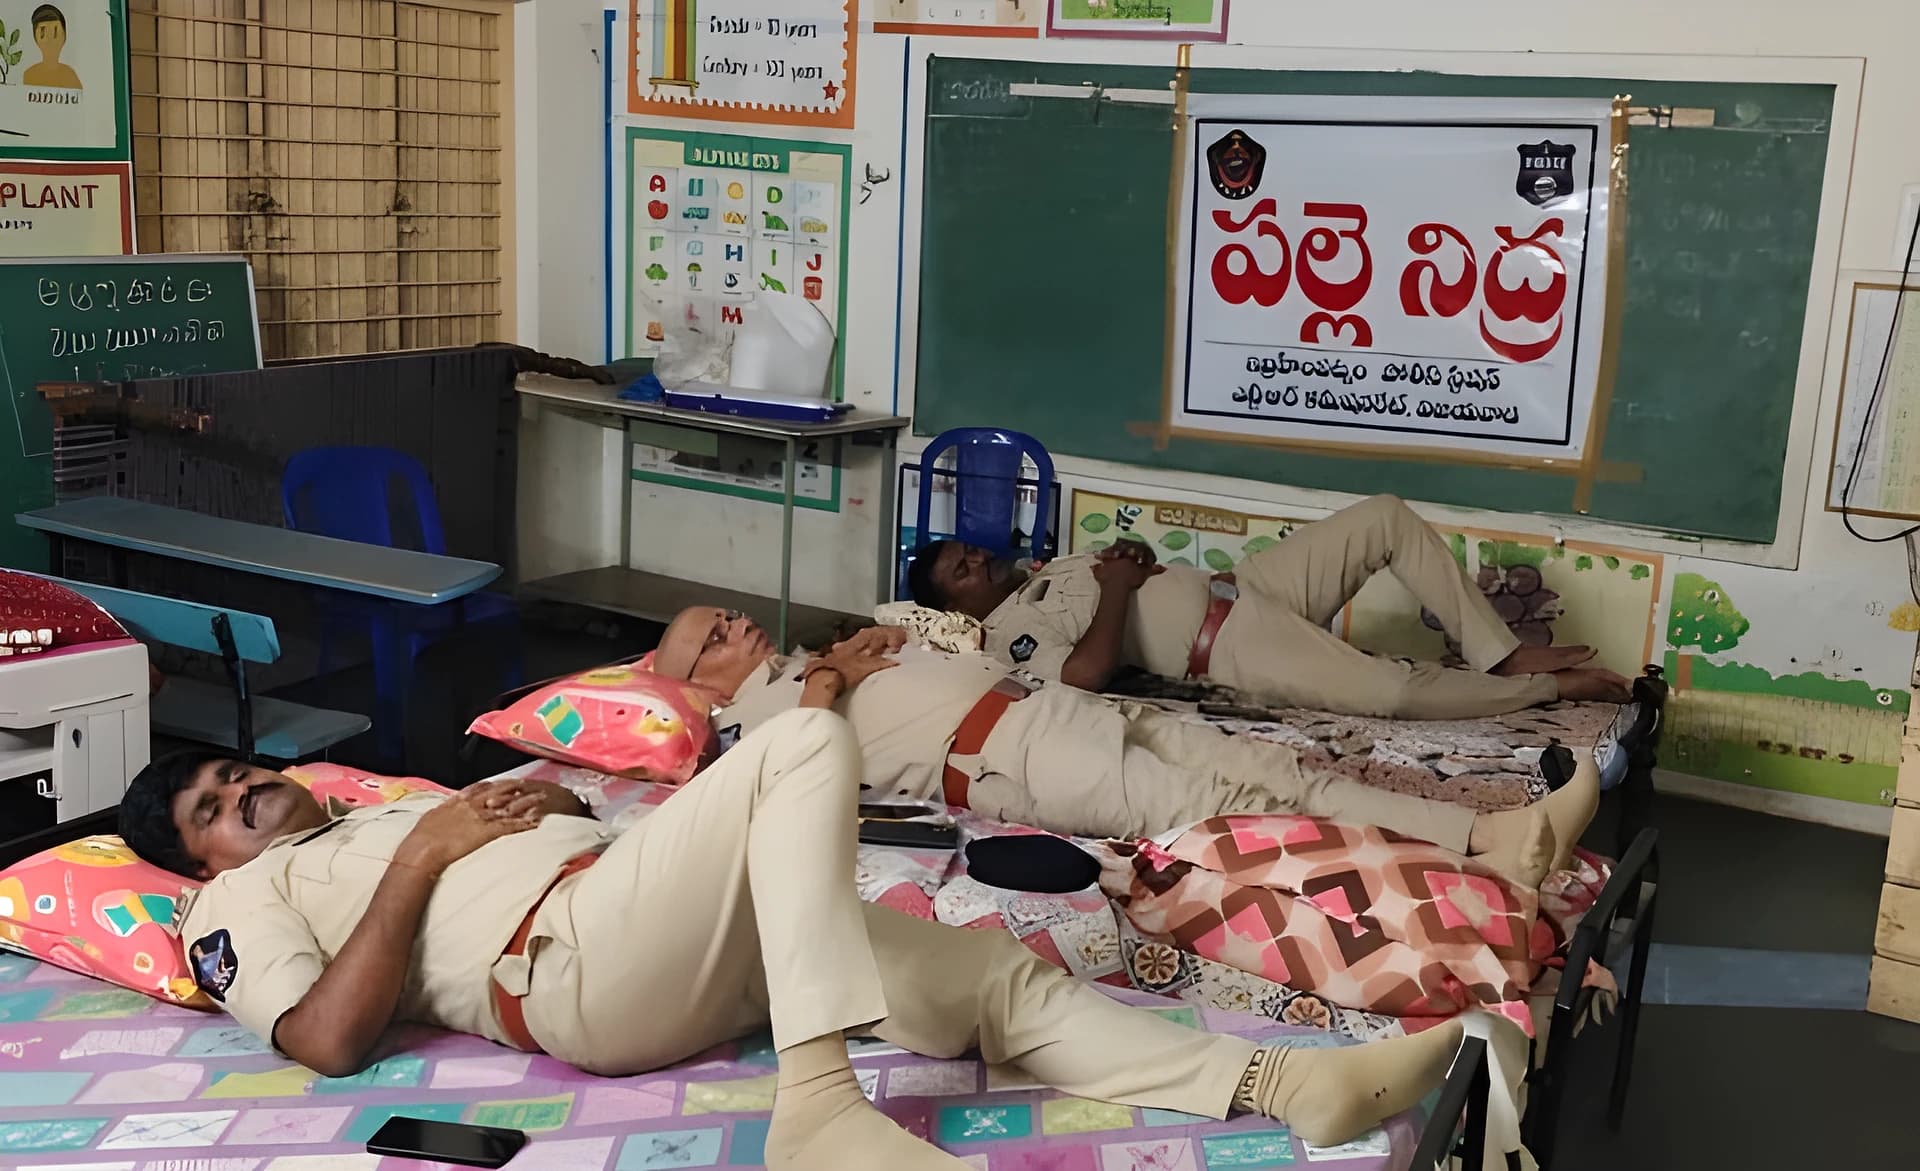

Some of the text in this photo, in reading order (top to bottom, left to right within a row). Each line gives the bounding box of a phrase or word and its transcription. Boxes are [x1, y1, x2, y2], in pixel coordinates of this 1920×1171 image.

[649, 174, 667, 193] A
[0, 182, 99, 209] PLANT
[766, 186, 783, 204] D
[725, 243, 744, 262] H
[806, 253, 822, 271] J
[1211, 198, 1568, 363] పల్లె నిద్ర
[721, 305, 744, 325] M
